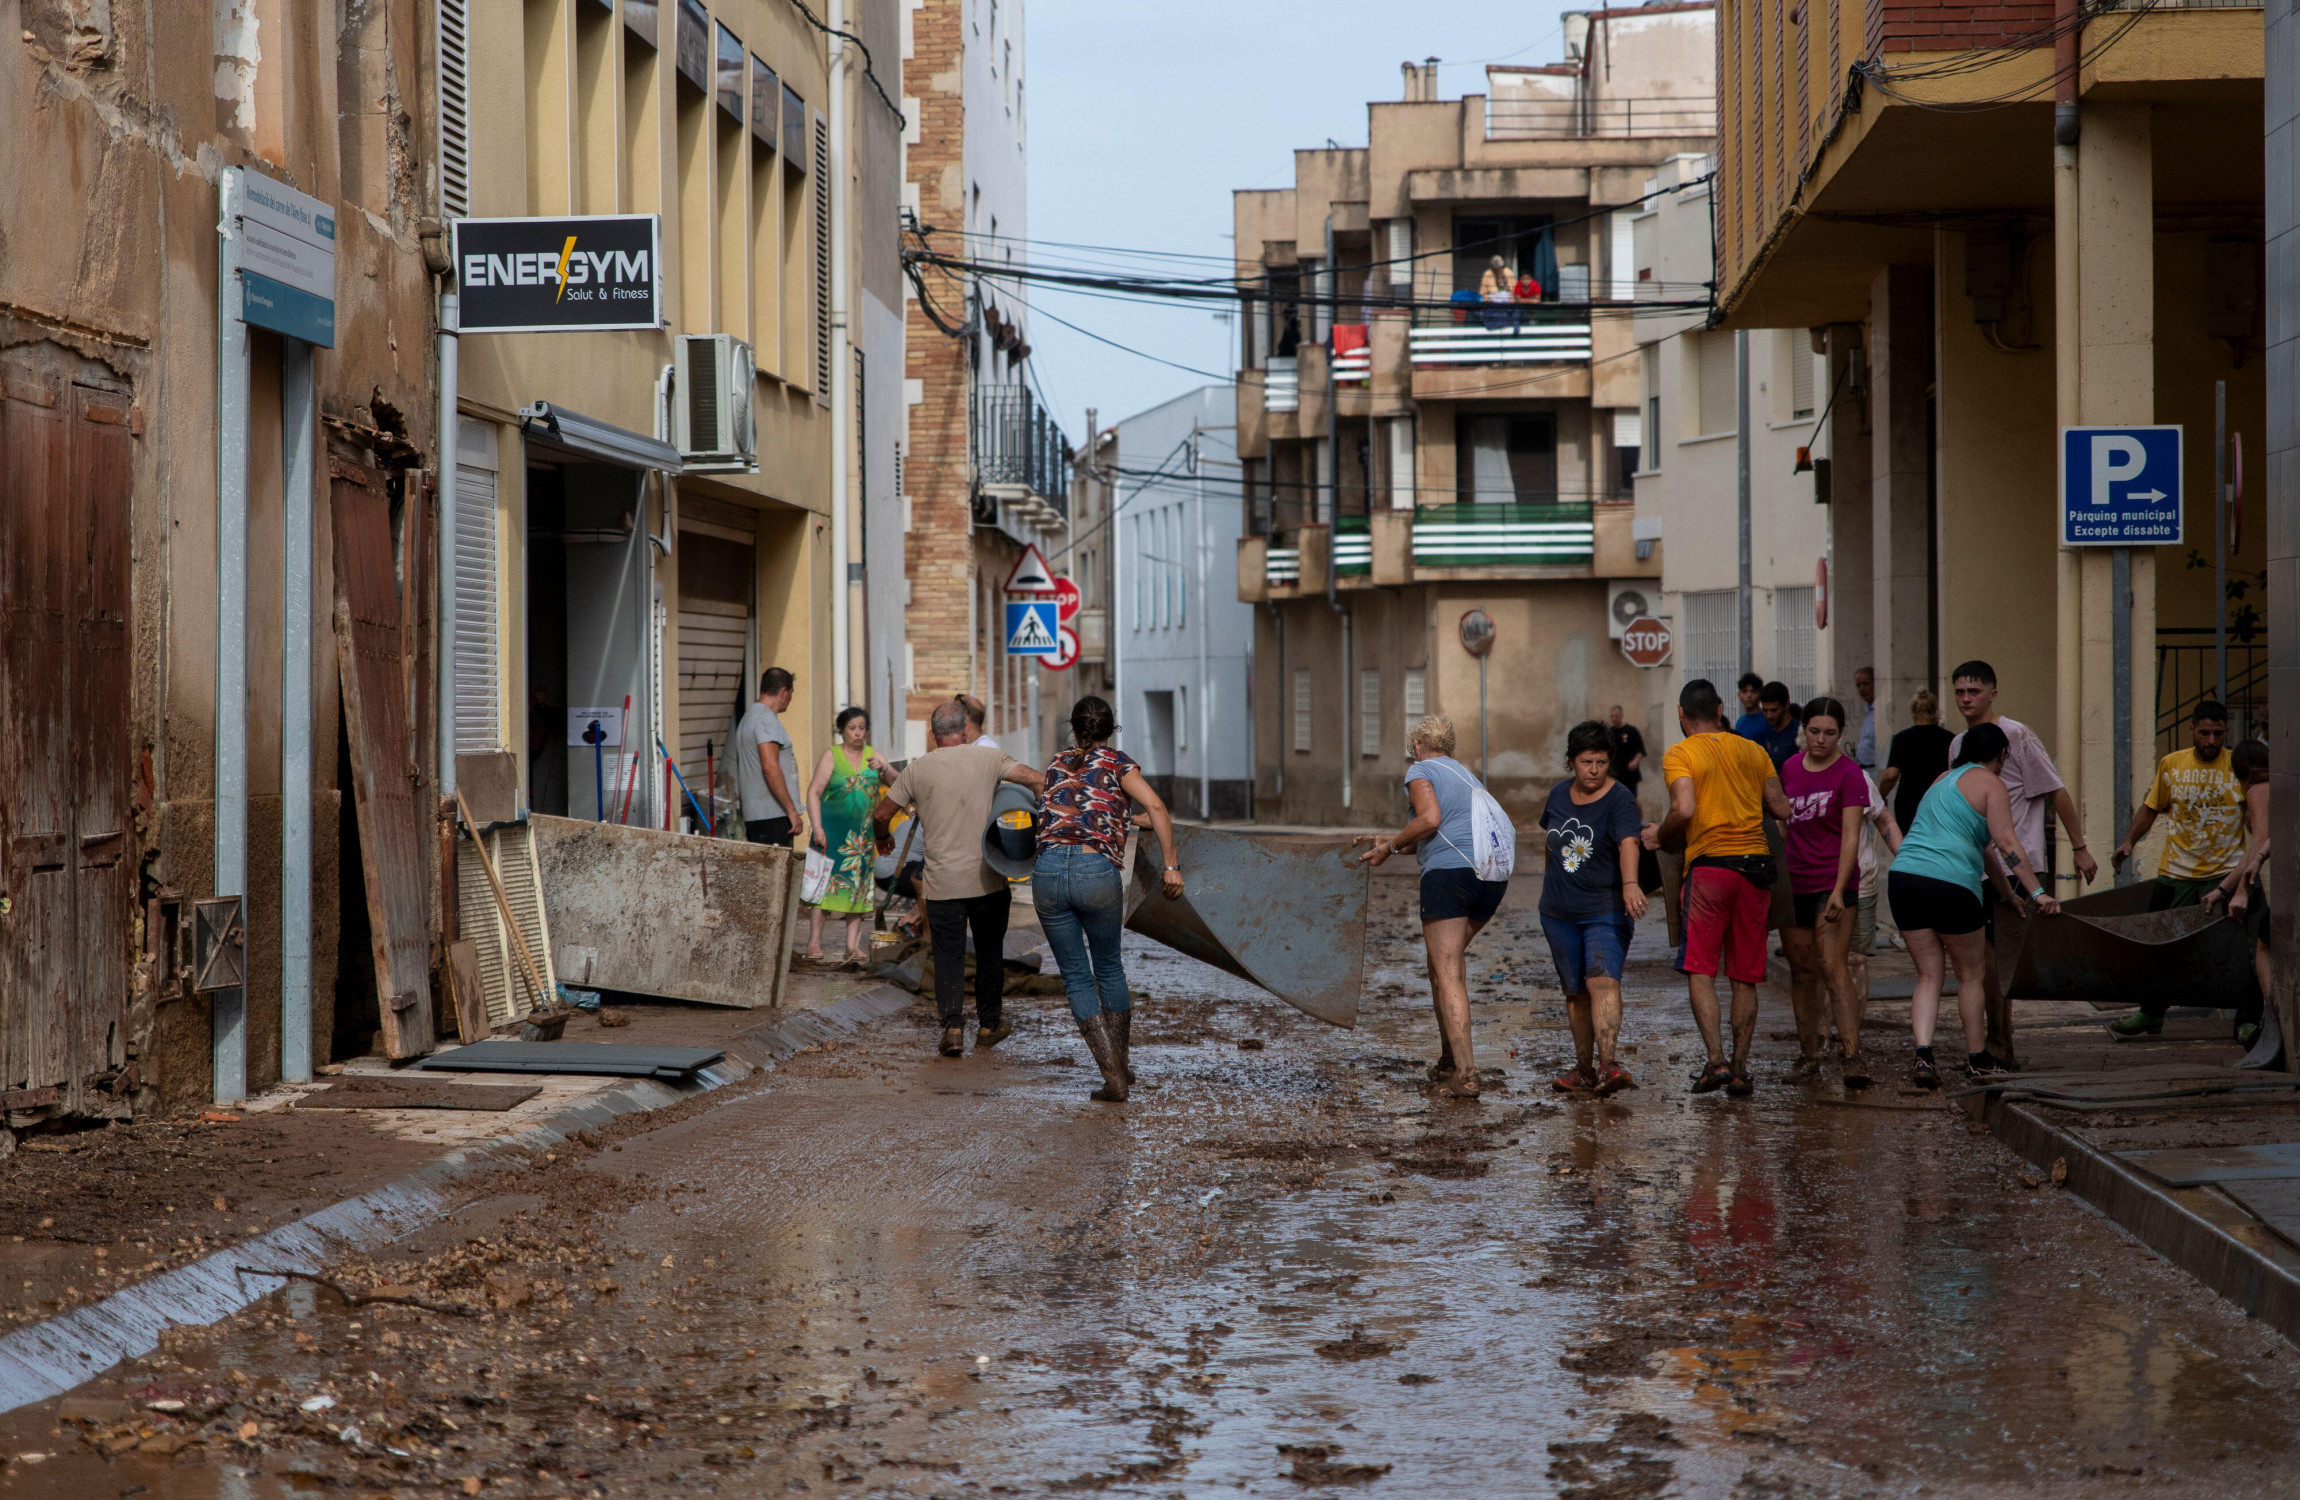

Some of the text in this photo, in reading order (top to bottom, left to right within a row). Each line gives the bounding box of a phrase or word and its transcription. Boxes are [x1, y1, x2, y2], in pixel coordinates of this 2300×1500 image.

[464, 250, 649, 286] ENERGYM
[567, 288, 594, 300] Salut
[598, 287, 608, 300] &
[2091, 435, 2147, 505] P
[2069, 509, 2176, 523] Pàrquing municipal
[2074, 524, 2171, 538] Excepte dissabte
[1625, 632, 1670, 652] STOP
